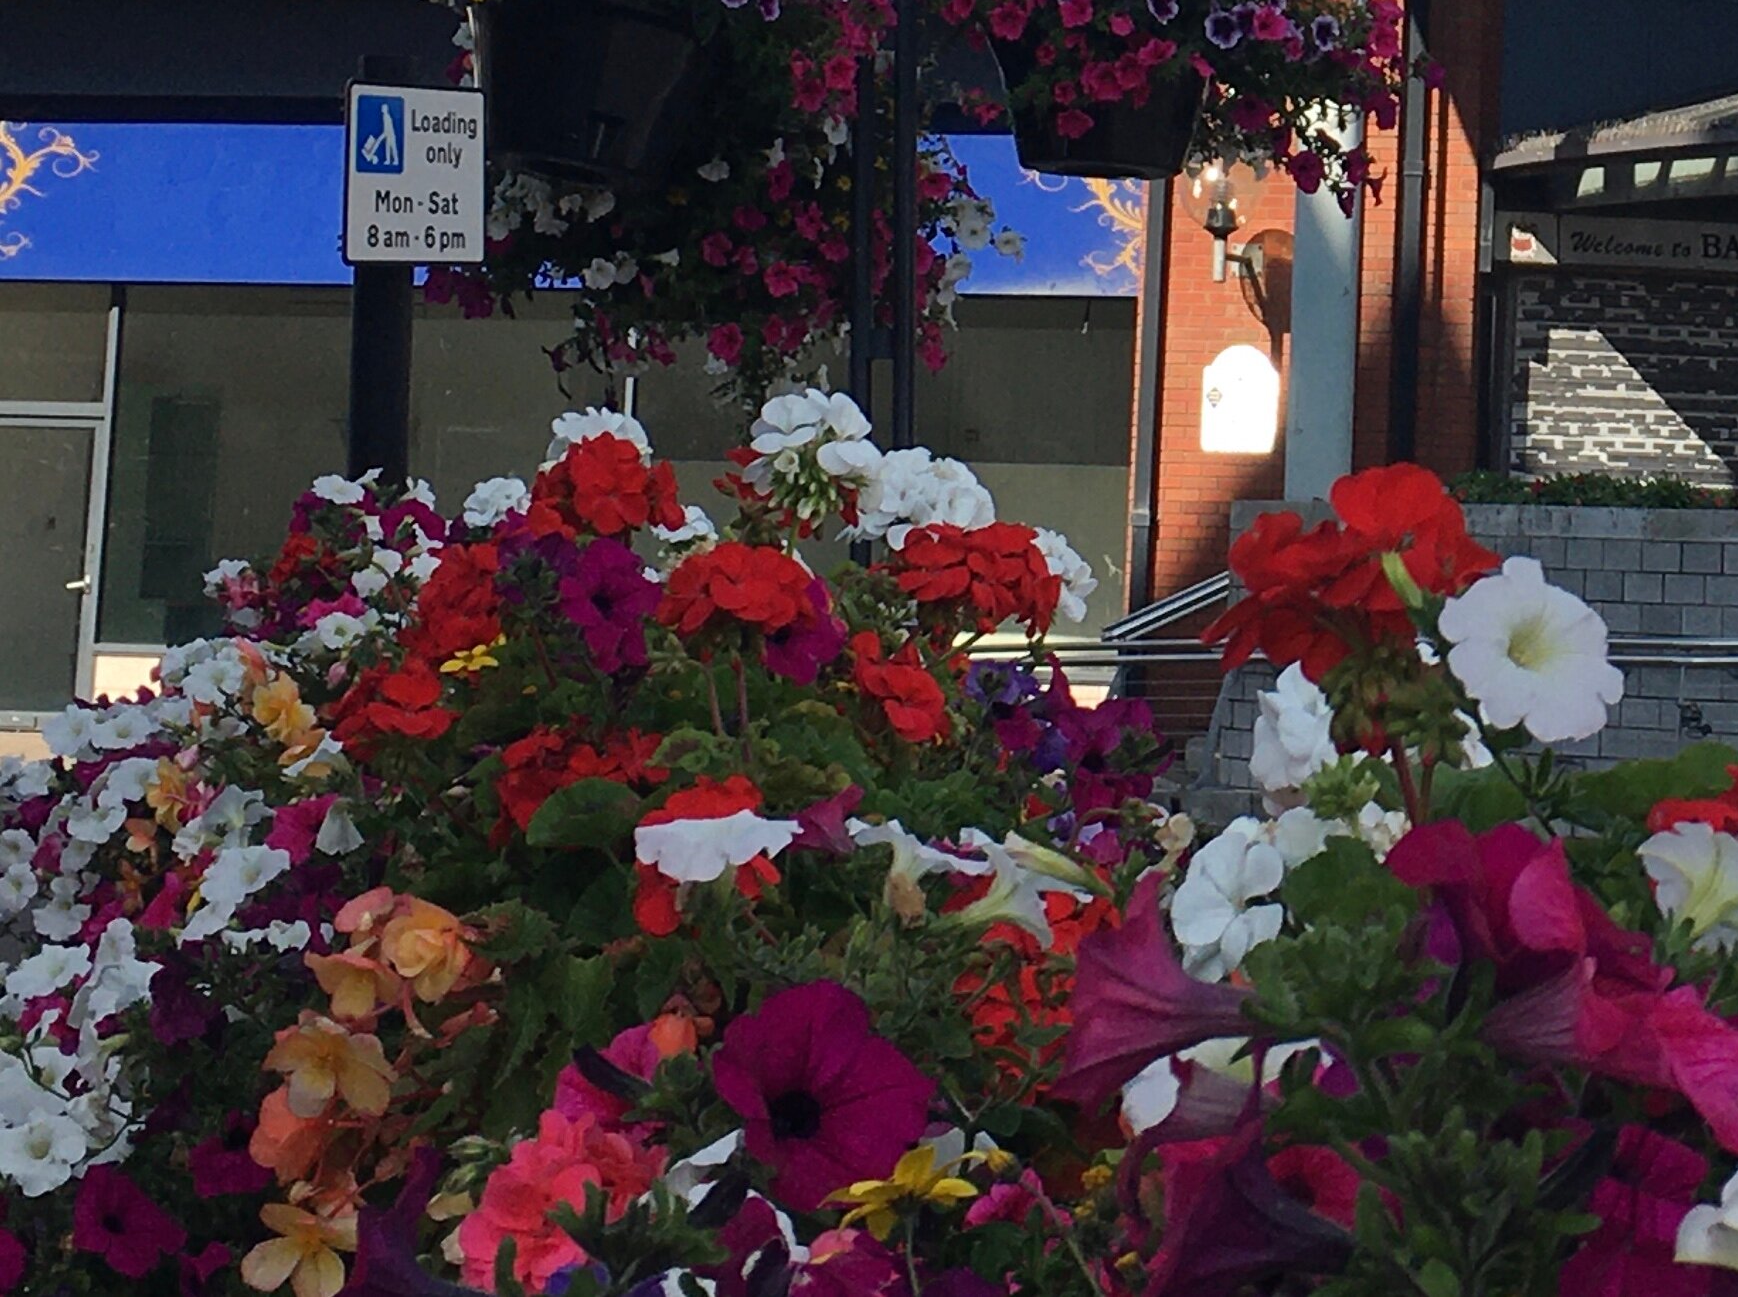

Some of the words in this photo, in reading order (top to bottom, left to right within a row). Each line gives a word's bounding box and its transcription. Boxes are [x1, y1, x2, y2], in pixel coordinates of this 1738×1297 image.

[411, 109, 477, 139] Loading
[426, 143, 463, 168] only
[375, 190, 413, 213] Mon
[428, 191, 459, 215] Sat
[1570, 232, 1664, 258] Welcome
[1672, 242, 1692, 258] to
